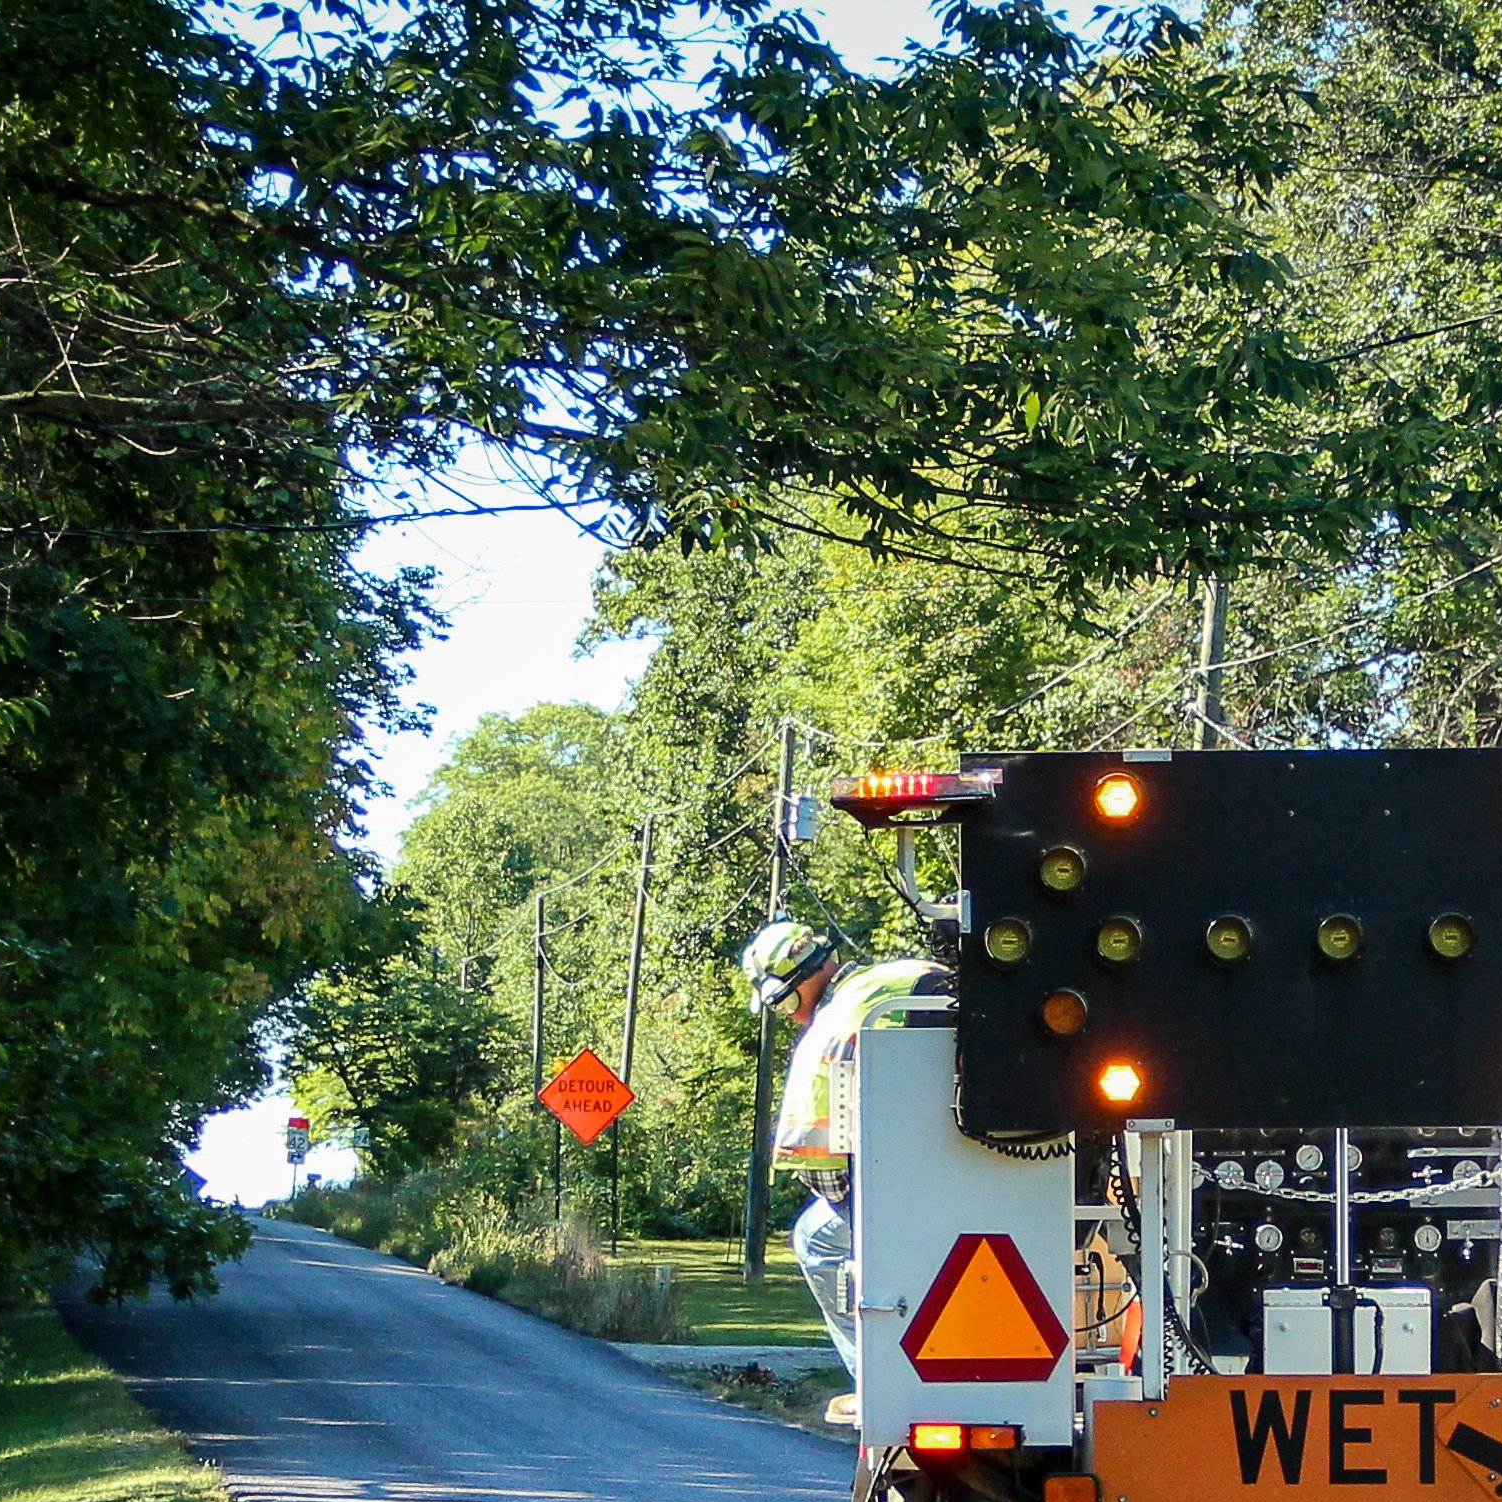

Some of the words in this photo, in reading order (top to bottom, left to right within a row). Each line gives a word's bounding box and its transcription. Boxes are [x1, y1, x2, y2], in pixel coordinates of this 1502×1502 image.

[558, 1080, 615, 1093] DETOUR
[562, 1099, 612, 1113] AHEAD
[289, 1137, 305, 1149] 42
[1229, 1389, 1457, 1485] WET
